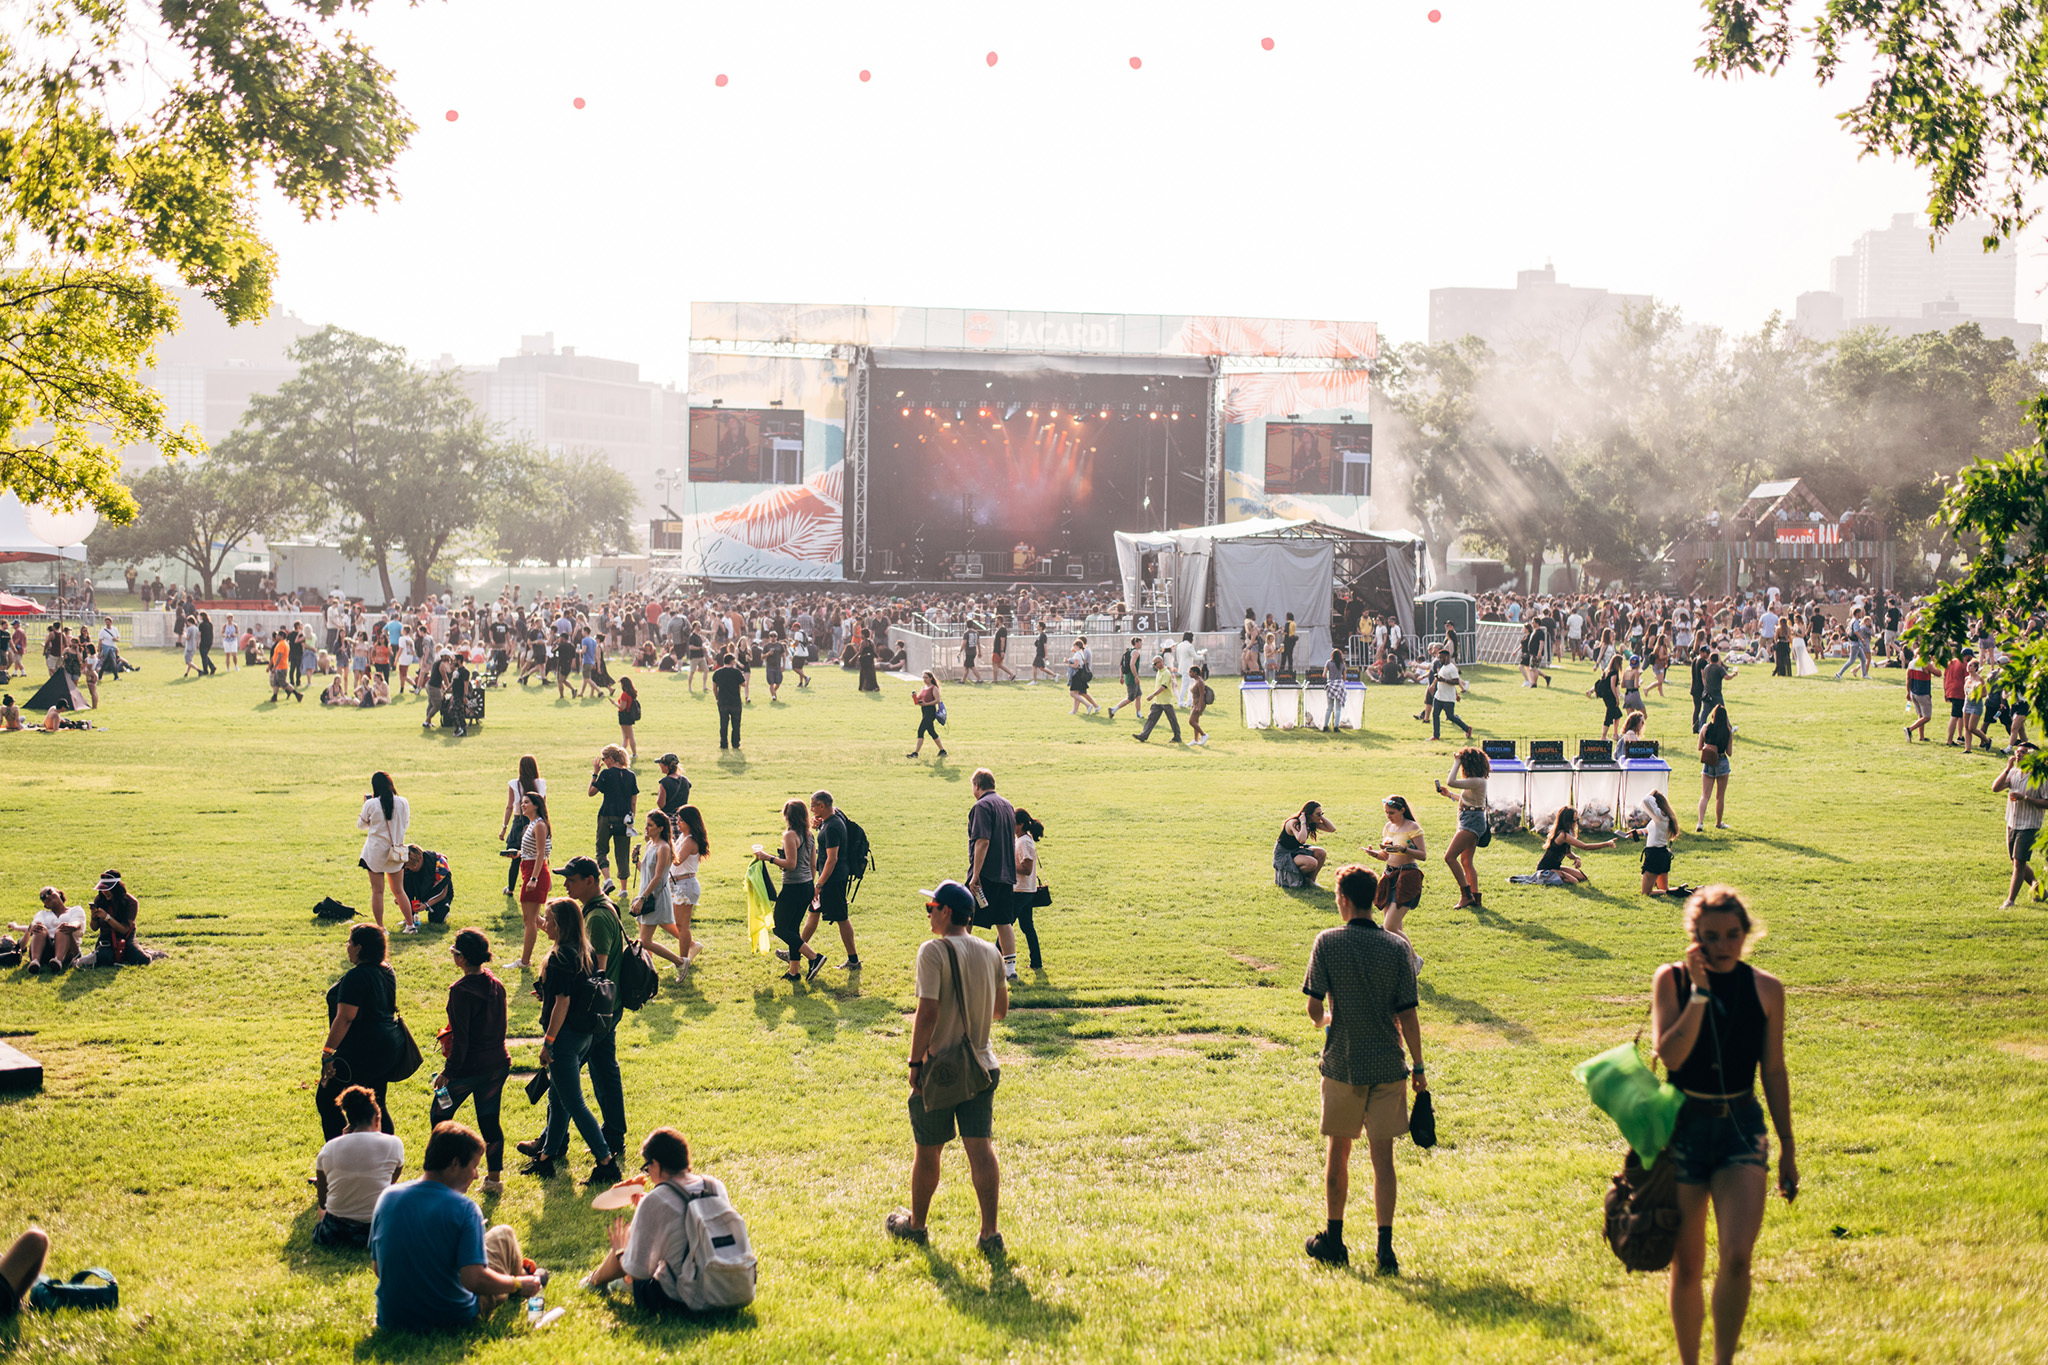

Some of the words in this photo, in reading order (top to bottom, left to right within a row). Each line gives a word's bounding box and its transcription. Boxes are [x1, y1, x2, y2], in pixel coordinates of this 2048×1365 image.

[1005, 316, 1117, 347] BACARDÍ
[1779, 532, 1815, 544] BACARDÍ
[1818, 524, 1839, 544] BAY
